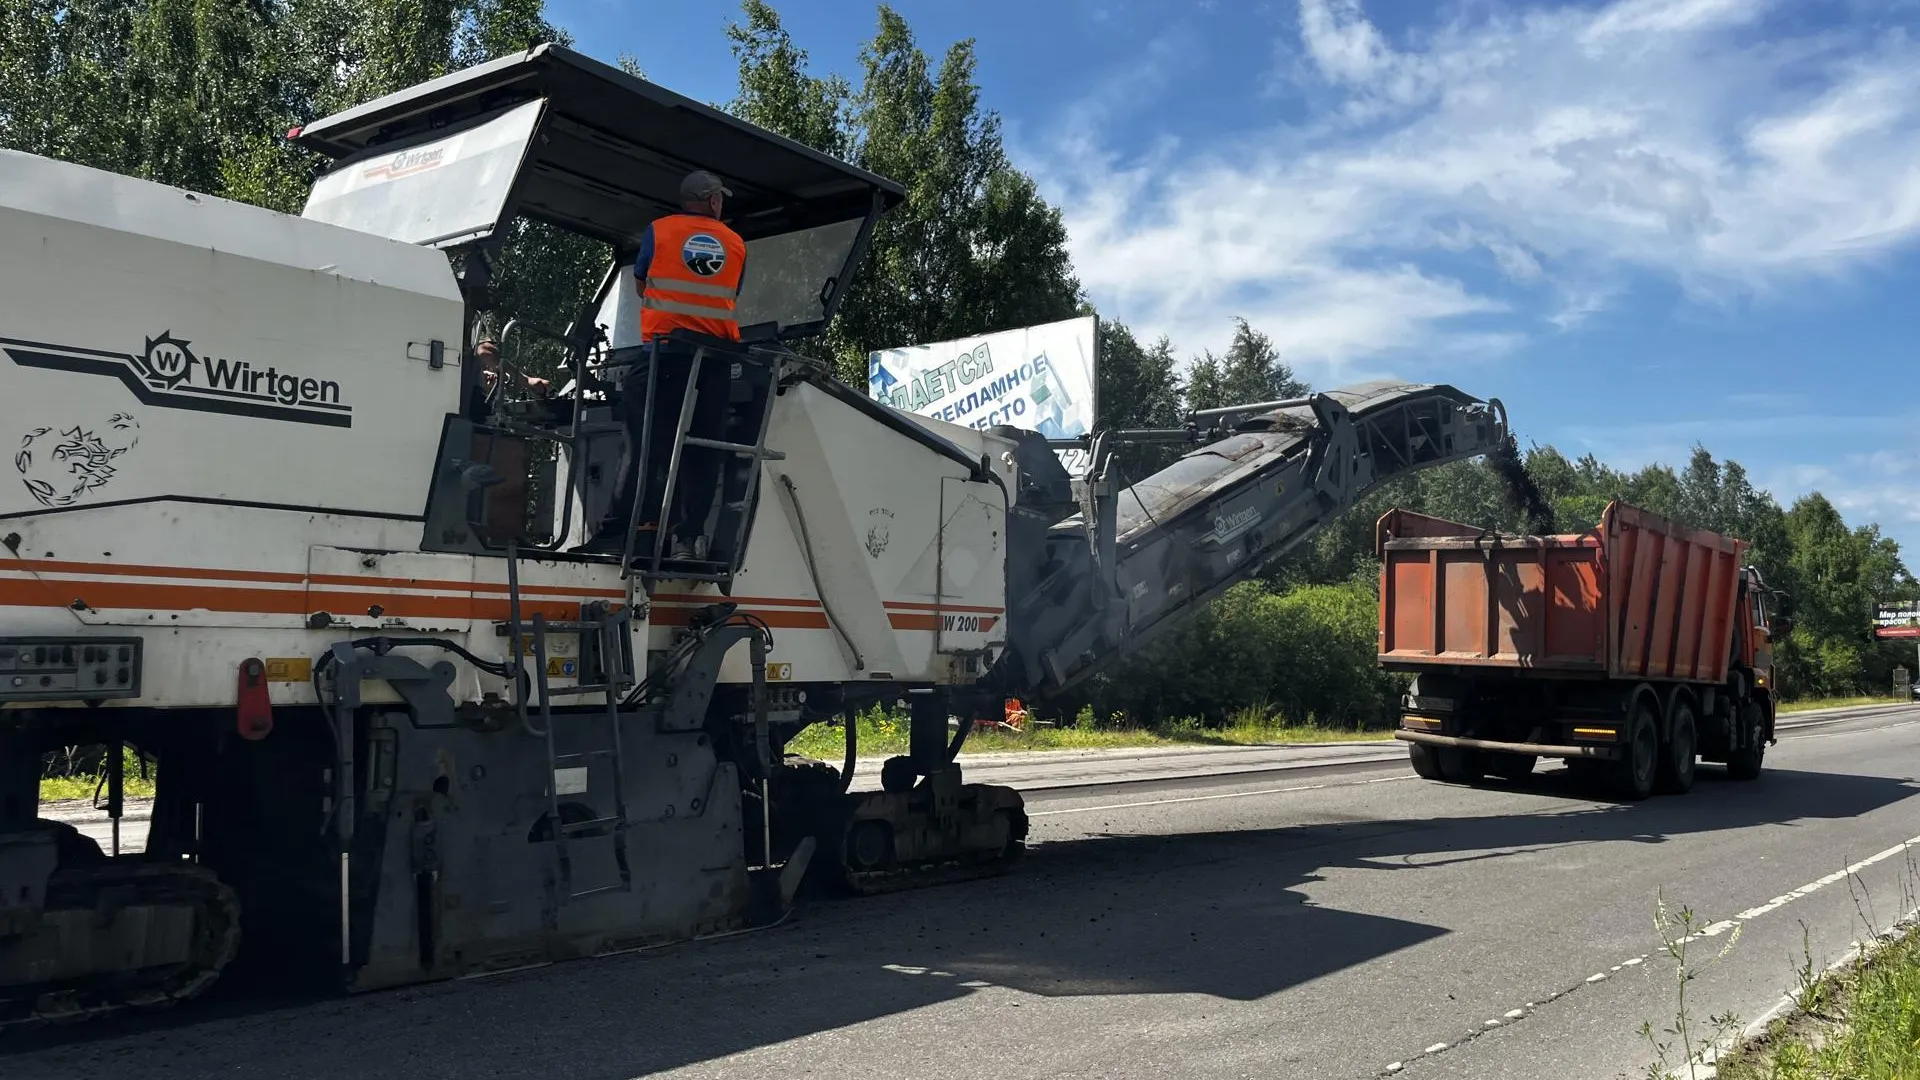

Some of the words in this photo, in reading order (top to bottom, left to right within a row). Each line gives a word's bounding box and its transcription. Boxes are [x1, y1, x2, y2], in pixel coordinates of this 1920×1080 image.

[156, 350, 181, 372] W
[203, 356, 340, 404] Wirtgen
[969, 398, 1025, 429] ЕСТО
[944, 615, 956, 632] W
[957, 615, 978, 632] 200
[1879, 611, 1896, 620] Мир
[1880, 619, 1907, 627] красок
